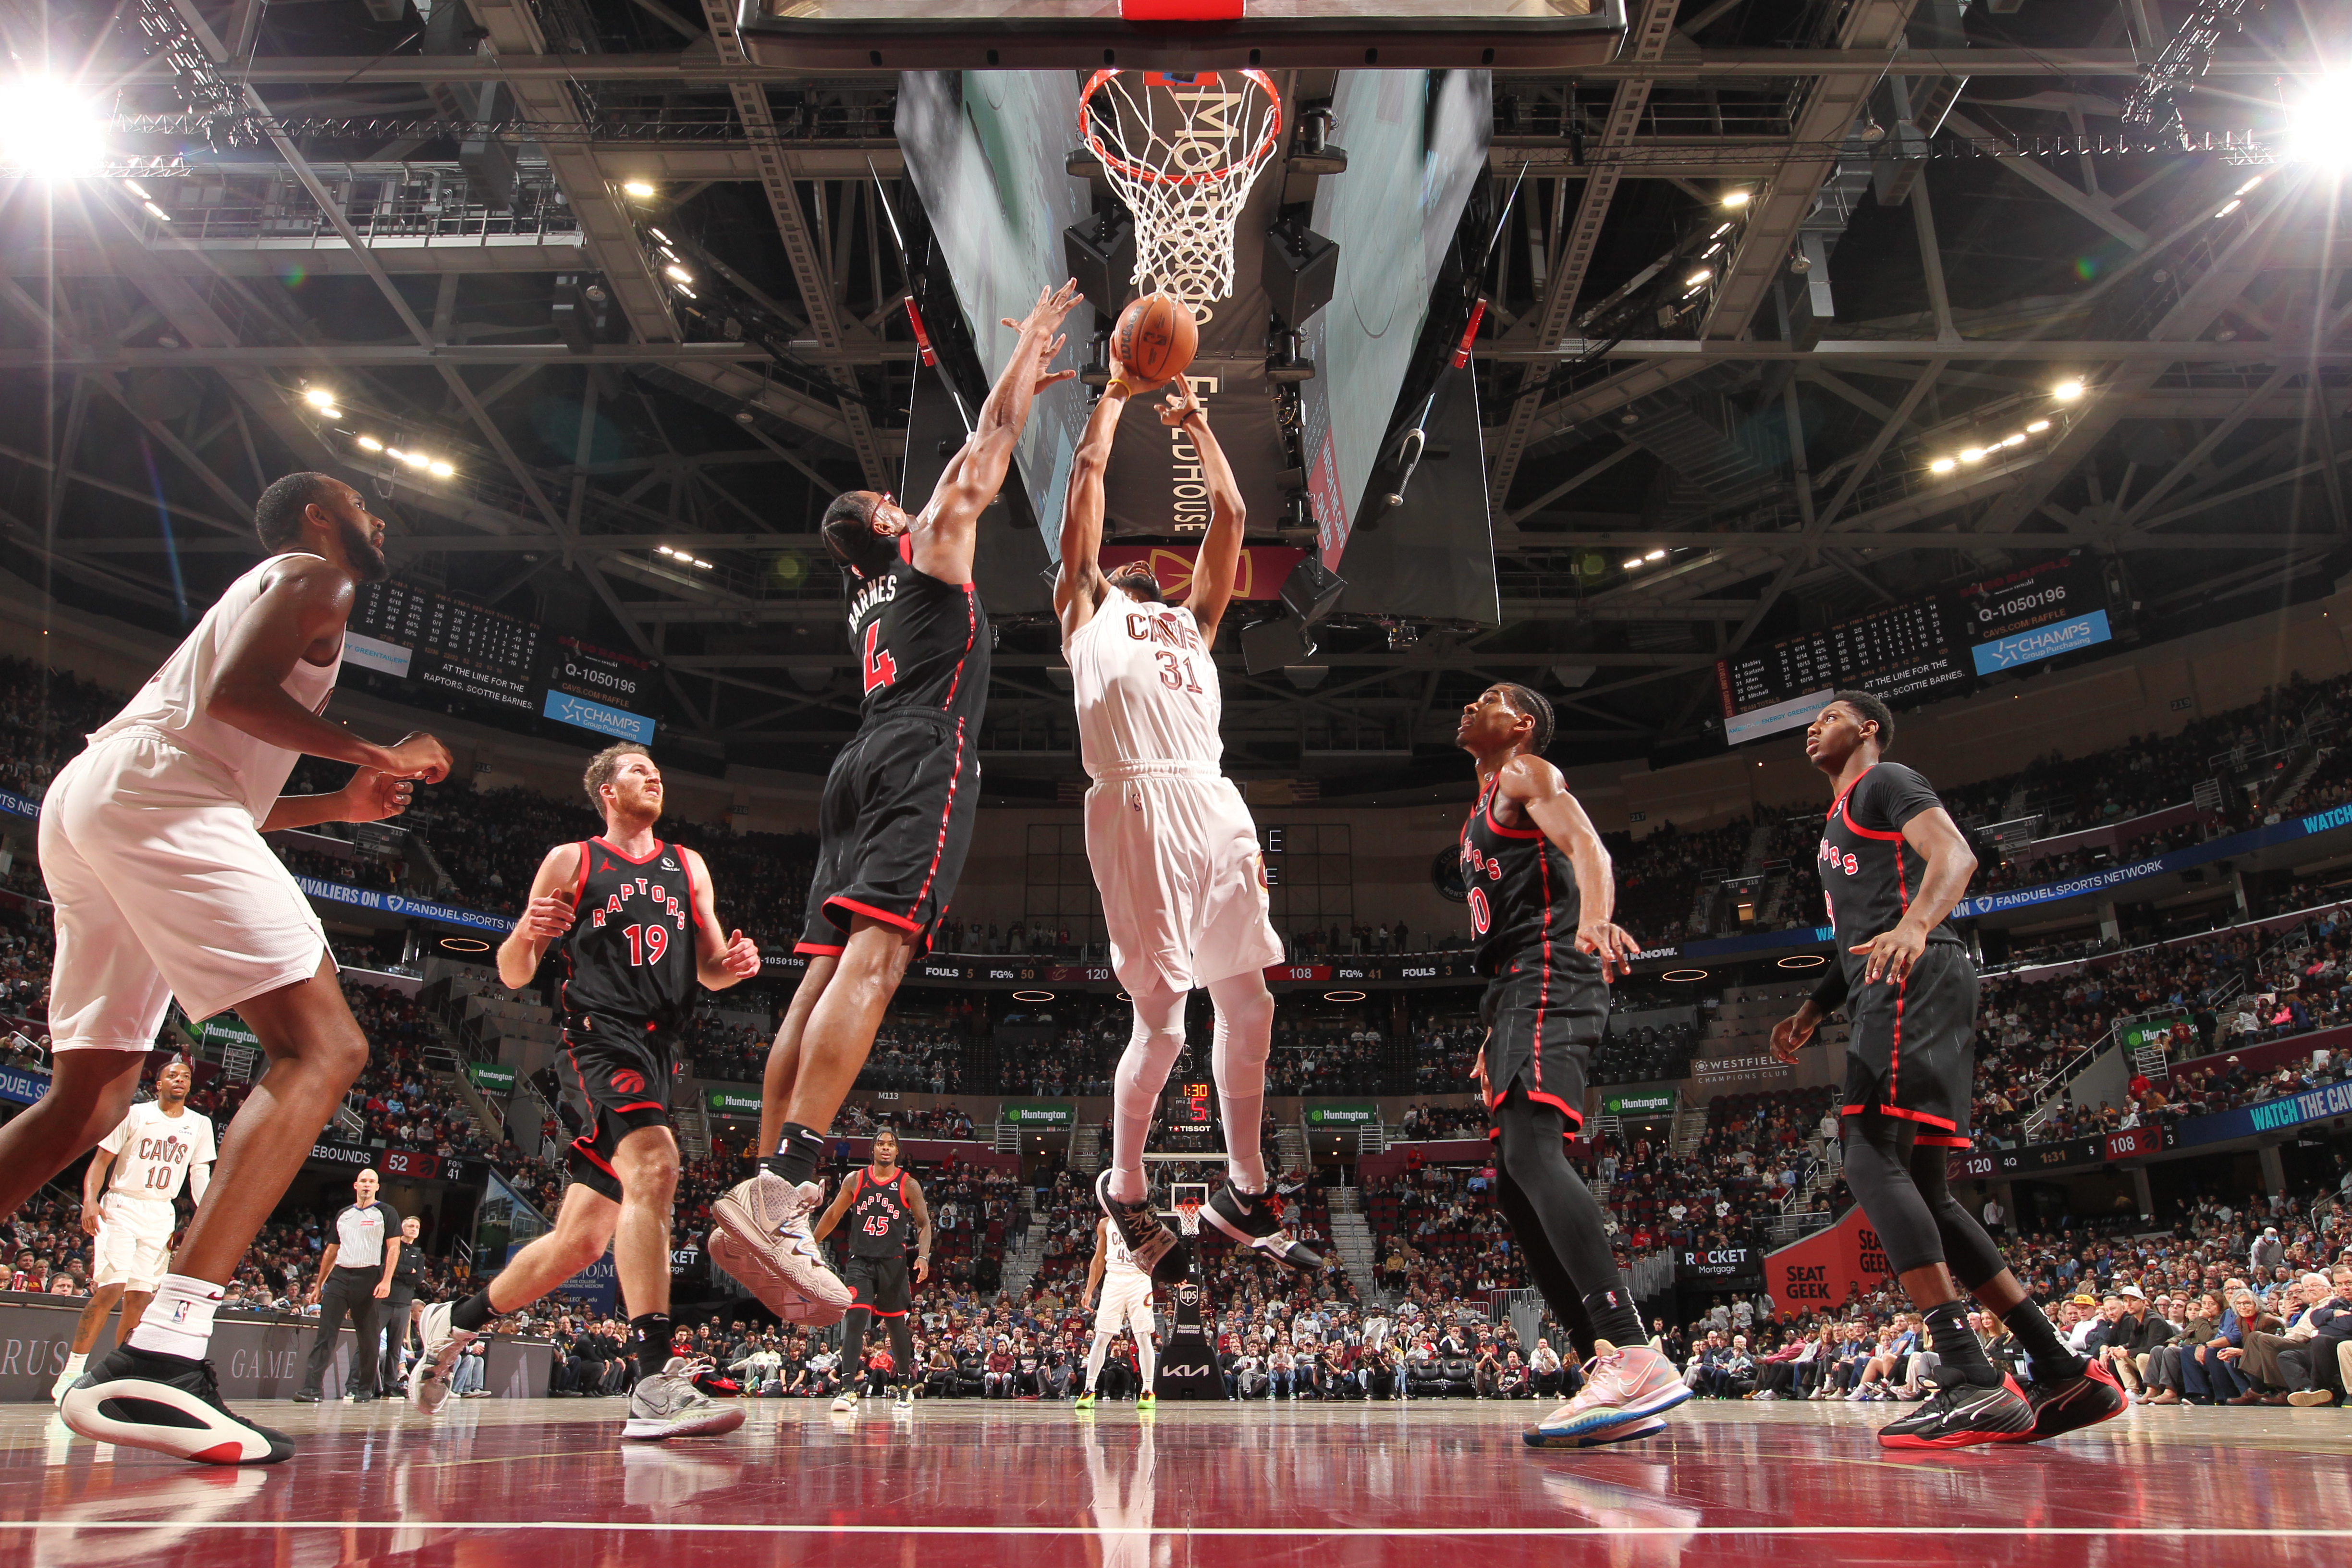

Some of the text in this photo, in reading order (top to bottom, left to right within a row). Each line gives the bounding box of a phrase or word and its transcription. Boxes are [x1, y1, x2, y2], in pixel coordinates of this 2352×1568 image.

[2014, 578, 2034, 589] oswald
[847, 575, 897, 634] BARNES
[1979, 586, 2066, 622] Q-1050196
[1983, 608, 2066, 638] CAVS.COM/RAFFLE
[2018, 622, 2090, 652] CHAMPS
[2022, 637, 2090, 660] Group Purchasing
[864, 618, 897, 697] 4
[1742, 660, 1761, 668] Mobley
[442, 663, 524, 692] AT THE LINE FOR THE
[565, 663, 636, 693] Q-1050196
[1155, 650, 1202, 695] 31
[1717, 662, 1726, 691] CLEVELAND
[1744, 667, 1764, 676] Garland
[1875, 676, 1891, 686] THE
[1893, 670, 1911, 680] LINE
[1912, 665, 1929, 675] FOR
[1931, 660, 1948, 669] THE
[1894, 670, 1965, 695] SCOTTIE BARNES.
[424, 673, 533, 710] RAPTORS. SCOTTIE BARNES.
[562, 683, 629, 708] CAVS.COM/RAFFLE
[1749, 689, 1768, 699] Mitchell
[1740, 698, 1780, 712] TEAM TOTALS
[583, 720, 637, 740] Group Purchasing
[584, 708, 640, 732] CHAMPS
[1762, 713, 1785, 724] ENERGY
[2303, 805, 2352, 834] WATCH
[1953, 860, 2163, 918] ON FANDUEL SPORTS NETWORK
[361, 891, 380, 907] ON
[406, 902, 460, 920] FANDUEL
[462, 913, 504, 928] SPORTS
[593, 878, 685, 930] RAPTORS
[1467, 887, 1490, 941] 0
[623, 924, 668, 966] 19
[926, 967, 1108, 979] FOULS 5 FG% 50 120
[1289, 966, 1452, 979] 108 FG% 41 FOULS 3
[205, 1023, 258, 1043] Huntington
[479, 1070, 513, 1081] Huntington
[1698, 1073, 1756, 1083] CHAMPIONS
[1184, 1084, 1208, 1097] 1:30
[1191, 1098, 1206, 1121] 5
[1621, 1097, 1668, 1109] Huntington
[2250, 1090, 2327, 1131] WATCH THE
[1021, 1110, 1066, 1121] Huntington
[1323, 1110, 1369, 1121] Huntington
[139, 1138, 188, 1164] CAVS
[2168, 1135, 2173, 1144] 3
[309, 1145, 463, 1171] EBOUNDS 52 FG%
[1967, 1136, 2135, 1174] 120 4Q 1:31 5 108
[145, 1166, 172, 1189] 10
[448, 1169, 459, 1179] 41
[857, 1193, 900, 1219] RAPTORS
[863, 1216, 889, 1236] 45
[1859, 1229, 1884, 1250] SEA
[1699, 1265, 1735, 1274] Mortgage
[1787, 1266, 1825, 1281] SEAT
[1181, 1290, 1197, 1302] ups
[1787, 1283, 1831, 1299] GEEK
[232, 1348, 297, 1378] GAME
